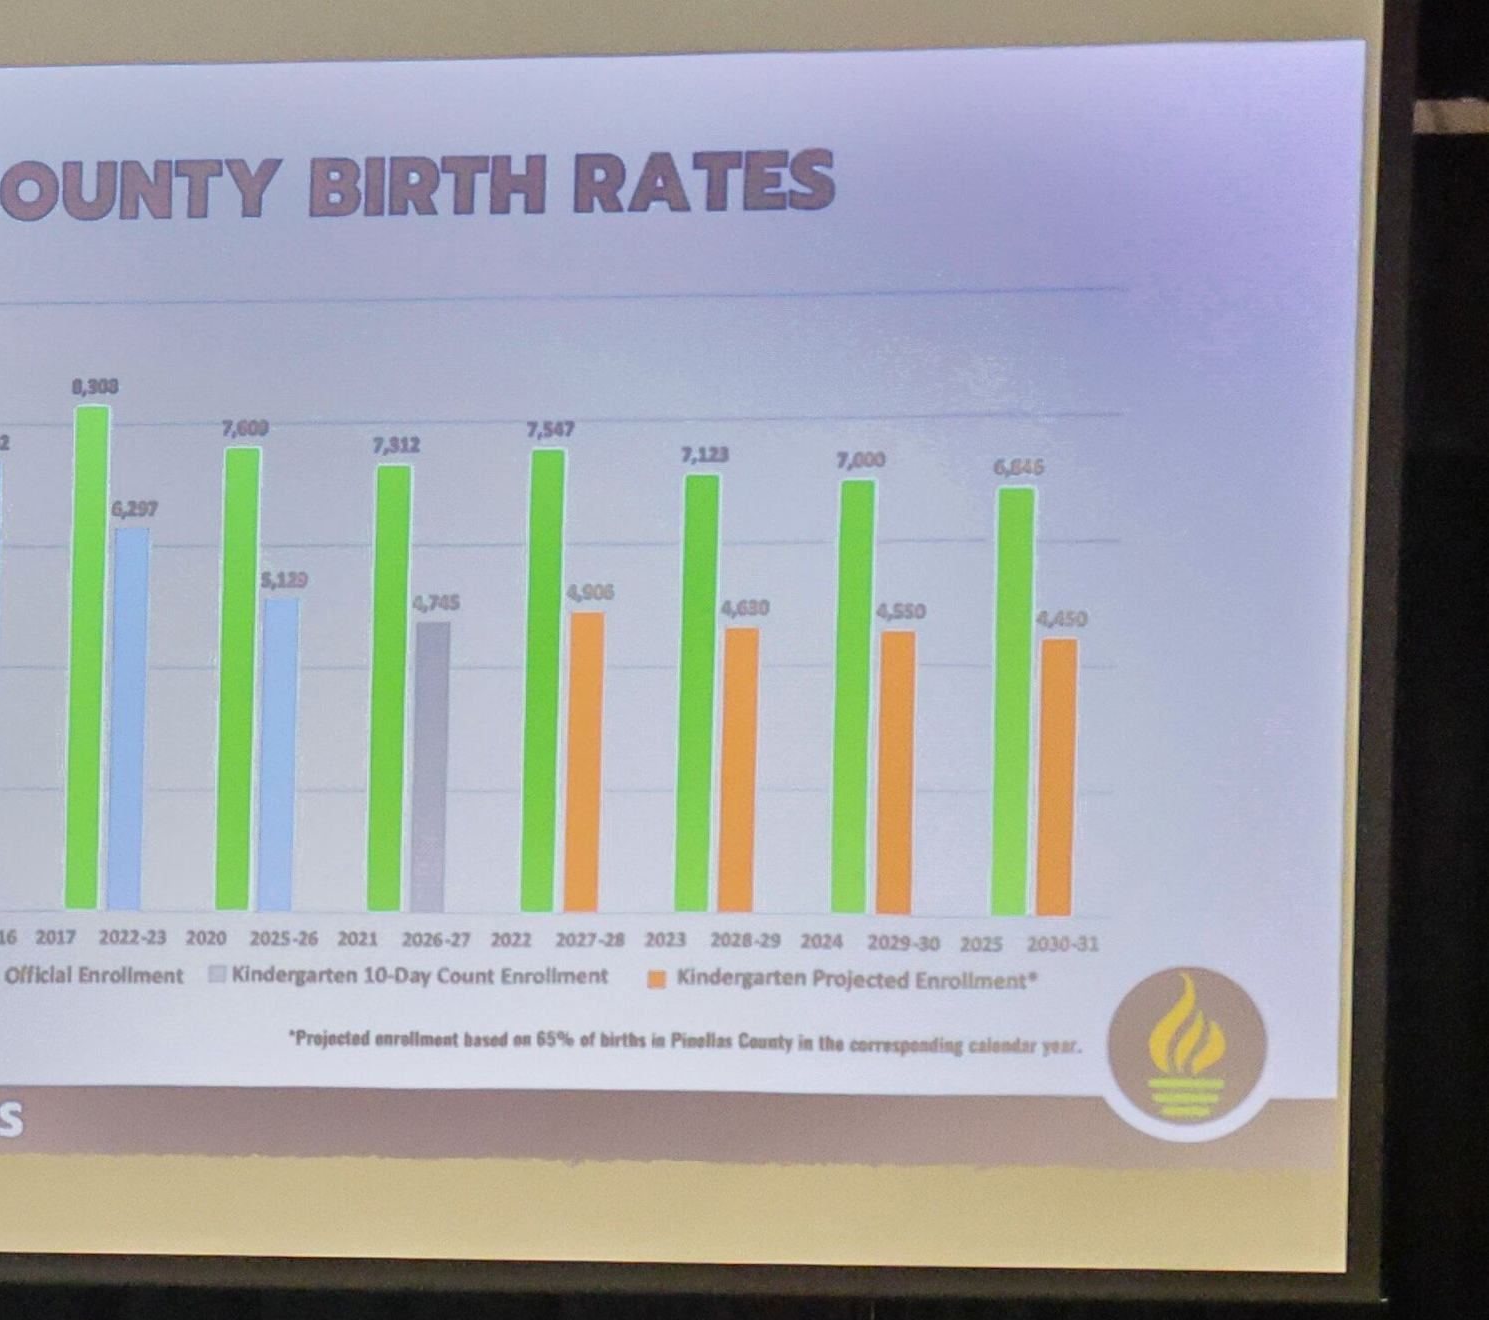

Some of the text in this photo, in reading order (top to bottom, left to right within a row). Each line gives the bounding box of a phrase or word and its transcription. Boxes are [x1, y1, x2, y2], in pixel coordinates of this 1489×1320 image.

[309, 154, 547, 218] BIRTH
[573, 148, 836, 213] RATES
[527, 420, 575, 440] 7,547
[35, 929, 76, 945] 2017
[99, 929, 167, 945] 2022-23
[186, 929, 227, 946] 2020
[250, 930, 319, 947] 2025-26
[338, 930, 378, 947] 2021
[402, 931, 471, 948] 2026-27
[491, 932, 531, 948] 2022
[556, 932, 625, 948] 2027-28
[645, 931, 687, 948] 2023
[711, 932, 781, 949] 2028-29
[801, 933, 844, 950] 2024
[868, 934, 941, 952] 2029-30
[960, 936, 1003, 953] 2025
[1027, 935, 1099, 953] 2030-31
[4, 964, 72, 985] Official
[78, 966, 184, 984] Enrollment
[232, 965, 609, 988] Kindergarten 10-Day Count Enrollment
[677, 967, 807, 990] Kindergarten
[813, 969, 910, 992] Projected
[375, 1031, 458, 1047] enrollment
[464, 1032, 508, 1047] based
[513, 1035, 531, 1047] on
[536, 1030, 575, 1047] 65%
[580, 1031, 596, 1047] of
[600, 1032, 646, 1048] births
[651, 1033, 665, 1048] in
[671, 1032, 733, 1049] Pinellas
[738, 1032, 793, 1053] County
[798, 1034, 813, 1051] in
[818, 1035, 844, 1052] the
[849, 1037, 964, 1057] corresponding
[968, 1037, 1037, 1054] calendar
